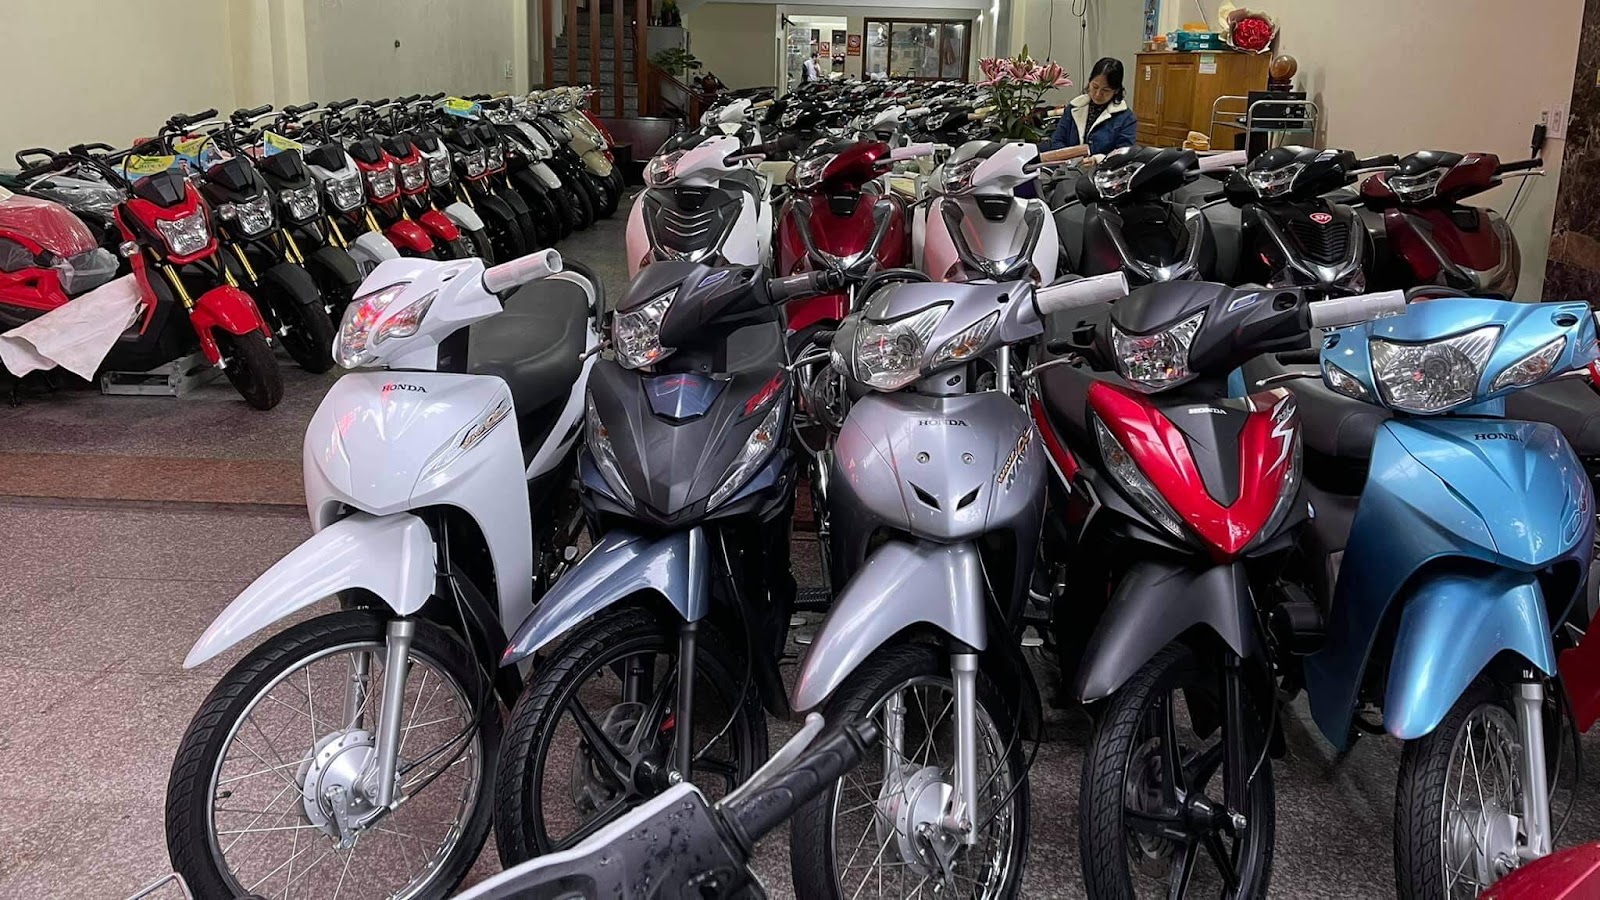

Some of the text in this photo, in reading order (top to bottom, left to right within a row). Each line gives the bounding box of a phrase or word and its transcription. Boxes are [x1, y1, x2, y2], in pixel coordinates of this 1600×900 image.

[382, 384, 427, 393] HONDA
[1188, 407, 1227, 415] HONDA
[919, 419, 968, 427] HONDA
